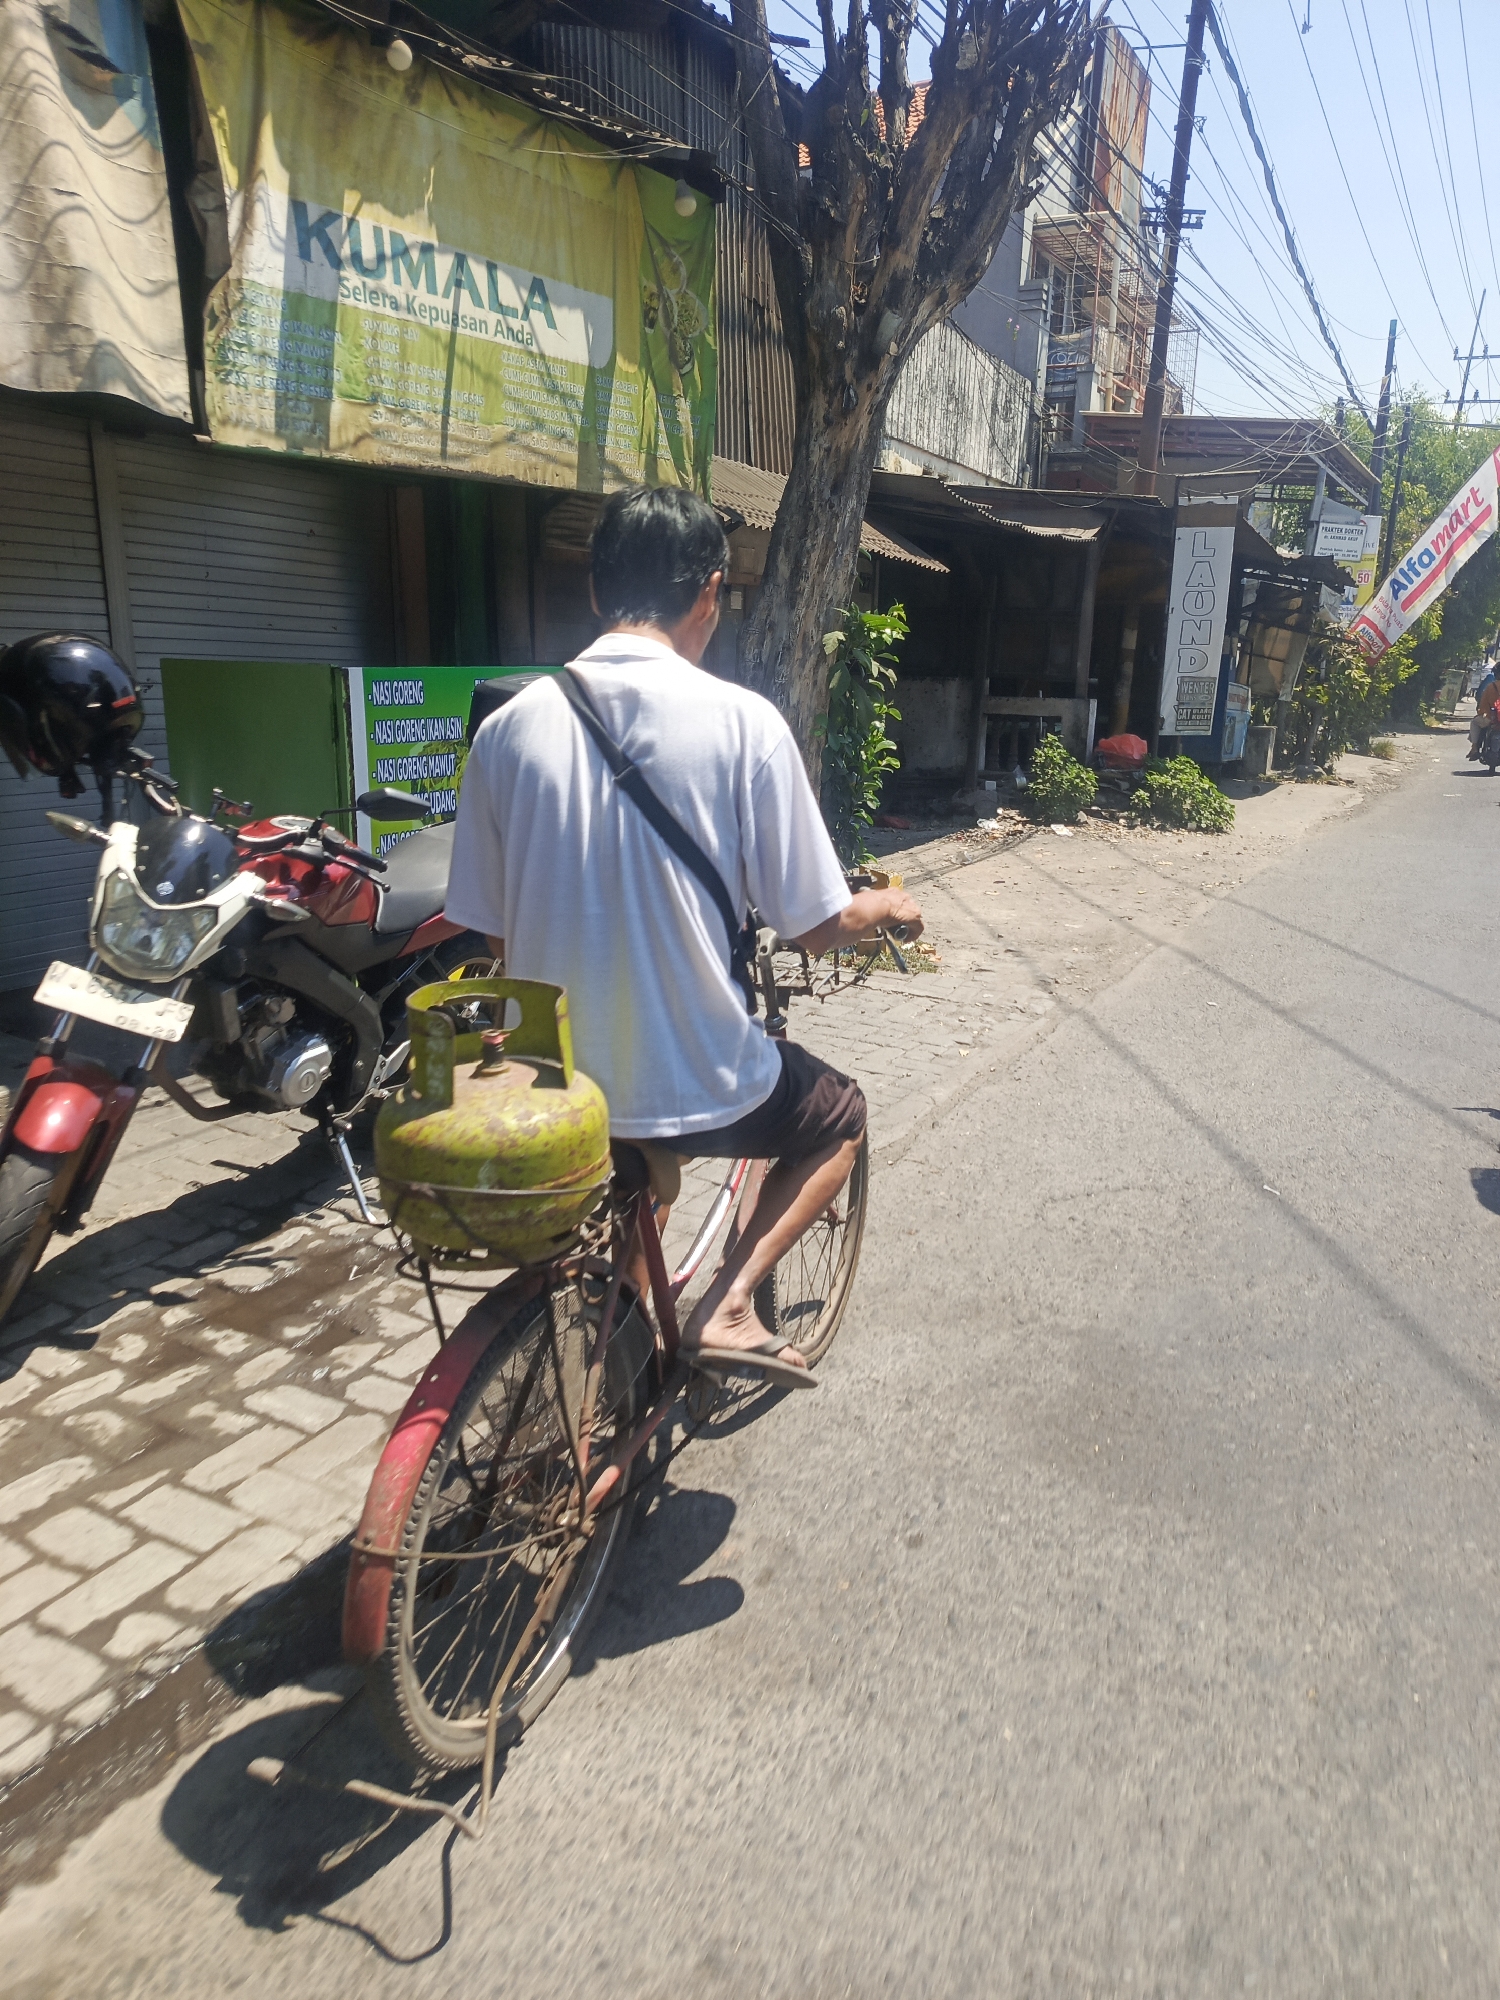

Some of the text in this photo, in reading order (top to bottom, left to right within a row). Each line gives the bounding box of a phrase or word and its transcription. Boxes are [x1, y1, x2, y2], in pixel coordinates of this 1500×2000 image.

[290, 199, 558, 331] KUMALA
[339, 277, 534, 348] Selera Kepuasan Anda
[1321, 526, 1344, 534] PRAKTEK
[1389, 486, 1485, 601] Alfamart
[1357, 573, 1370, 584] 50
[1173, 531, 1216, 714] LAUND
[393, 680, 424, 705] GORENG
[1178, 709, 1192, 720] CAT
[395, 718, 425, 744] GORENG
[426, 717, 445, 741] IKAN
[446, 716, 463, 740] ASIN
[397, 757, 428, 782] GORENG
[428, 753, 456, 778] MAWUT
[430, 789, 456, 814] UDANG
